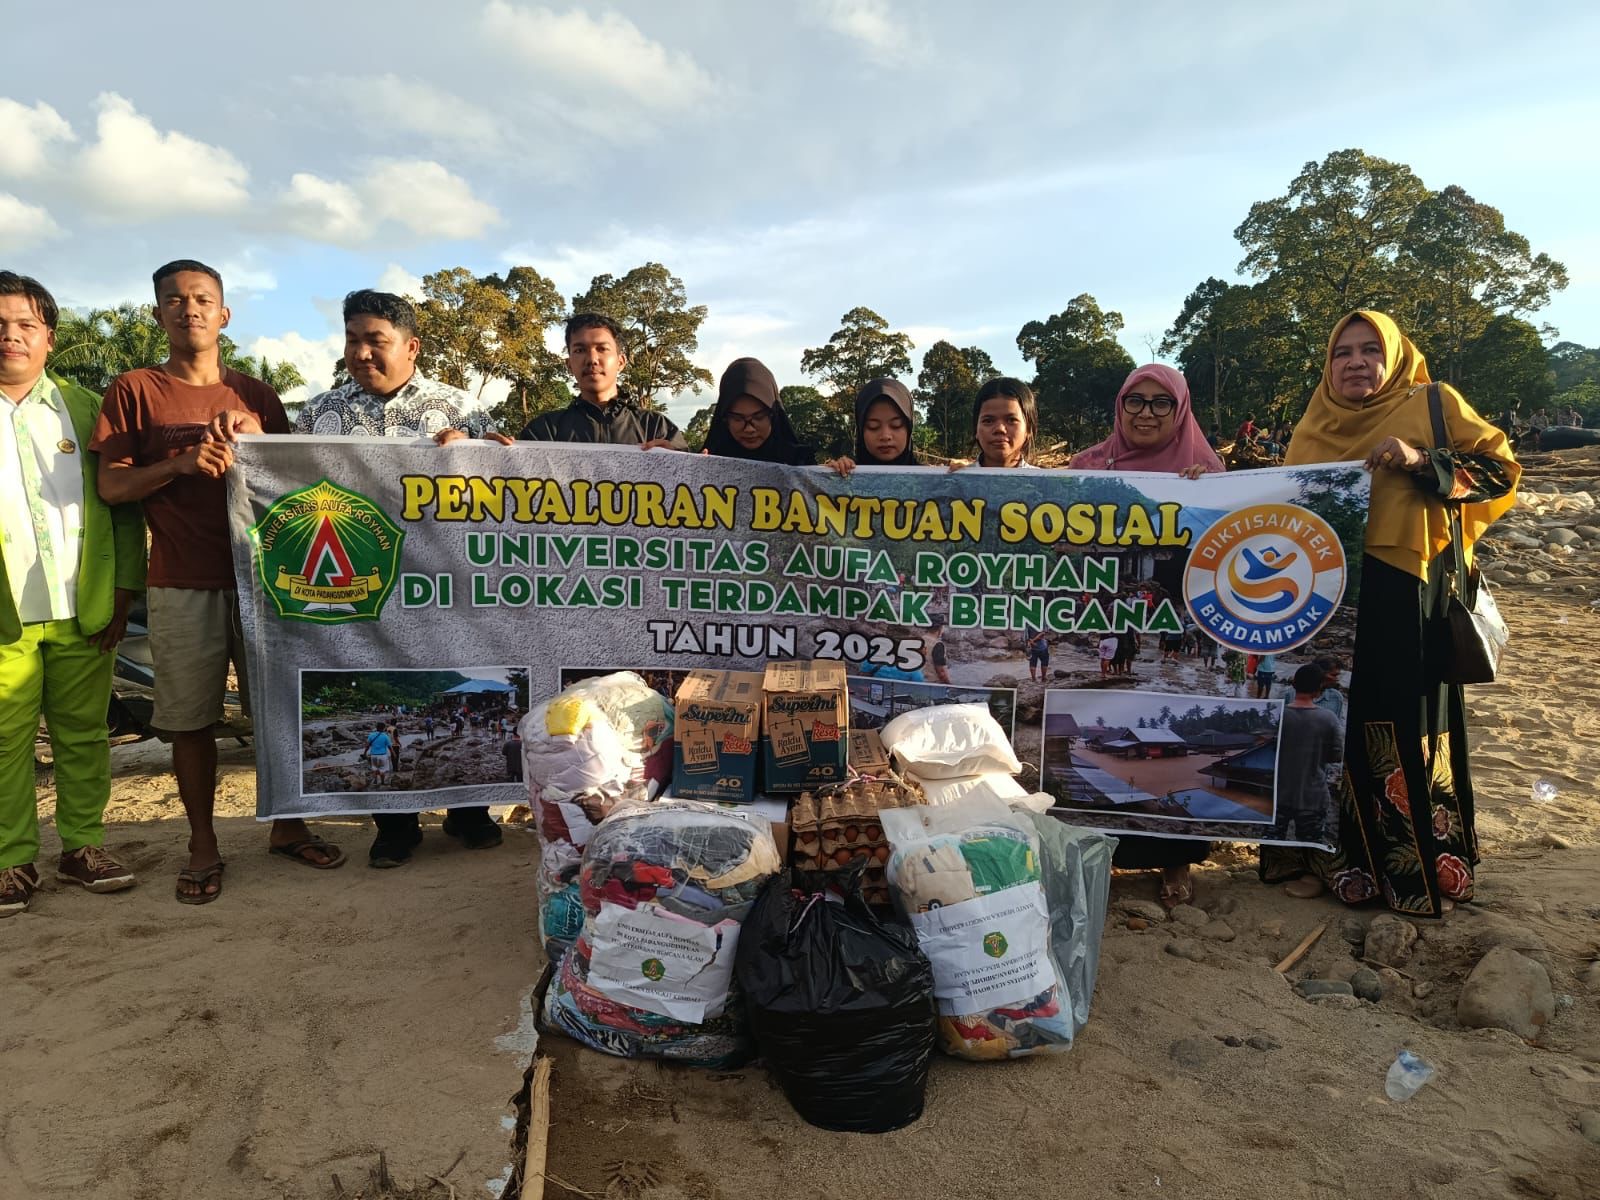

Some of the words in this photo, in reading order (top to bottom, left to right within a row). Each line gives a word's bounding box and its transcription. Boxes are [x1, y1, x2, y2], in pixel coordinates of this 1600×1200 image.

[262, 500, 318, 551] UNIVERSITAS
[321, 499, 353, 515] AUFA
[355, 509, 391, 551] ROYHAN
[401, 475, 739, 530] PENYALURAN
[751, 488, 985, 543] BANTUAN
[1000, 500, 1192, 547] SOSIAL
[1202, 513, 1334, 560] DIKTISAINTEK
[465, 532, 769, 575] UNIVERSITAS
[784, 543, 900, 583] AUFA
[915, 551, 1119, 595] ROYHAN
[401, 573, 454, 609] DI
[470, 573, 643, 610] LOKASI
[660, 577, 933, 628] TERDAMPAK
[949, 593, 1184, 634] BENCANA
[1200, 603, 1323, 644] BERDAMPAK
[646, 620, 798, 658] TAHUN
[814, 631, 925, 672] 2025
[716, 778, 741, 788] 40
[808, 766, 835, 776] 40
